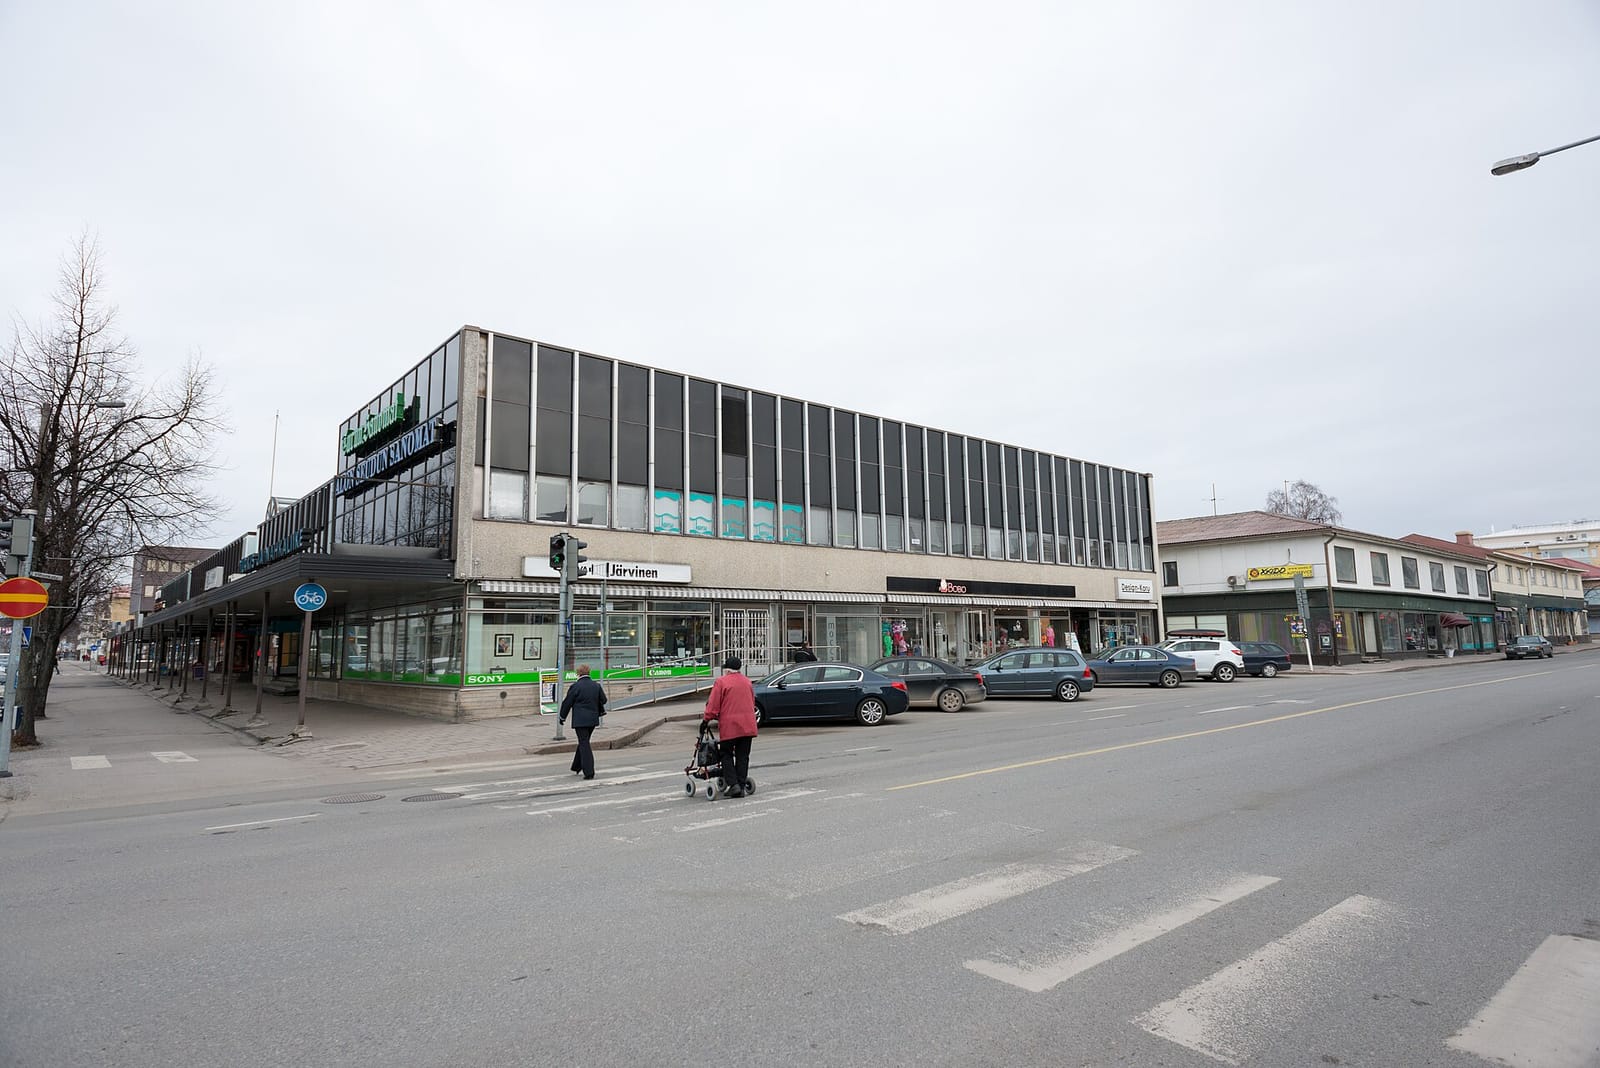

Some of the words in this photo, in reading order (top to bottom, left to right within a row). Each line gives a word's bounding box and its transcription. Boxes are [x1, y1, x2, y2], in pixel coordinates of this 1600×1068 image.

[389, 420, 436, 466] SANOMAT
[610, 564, 658, 578] Järvinen
[467, 675, 505, 684] SONY
[565, 672, 578, 680] Nik
